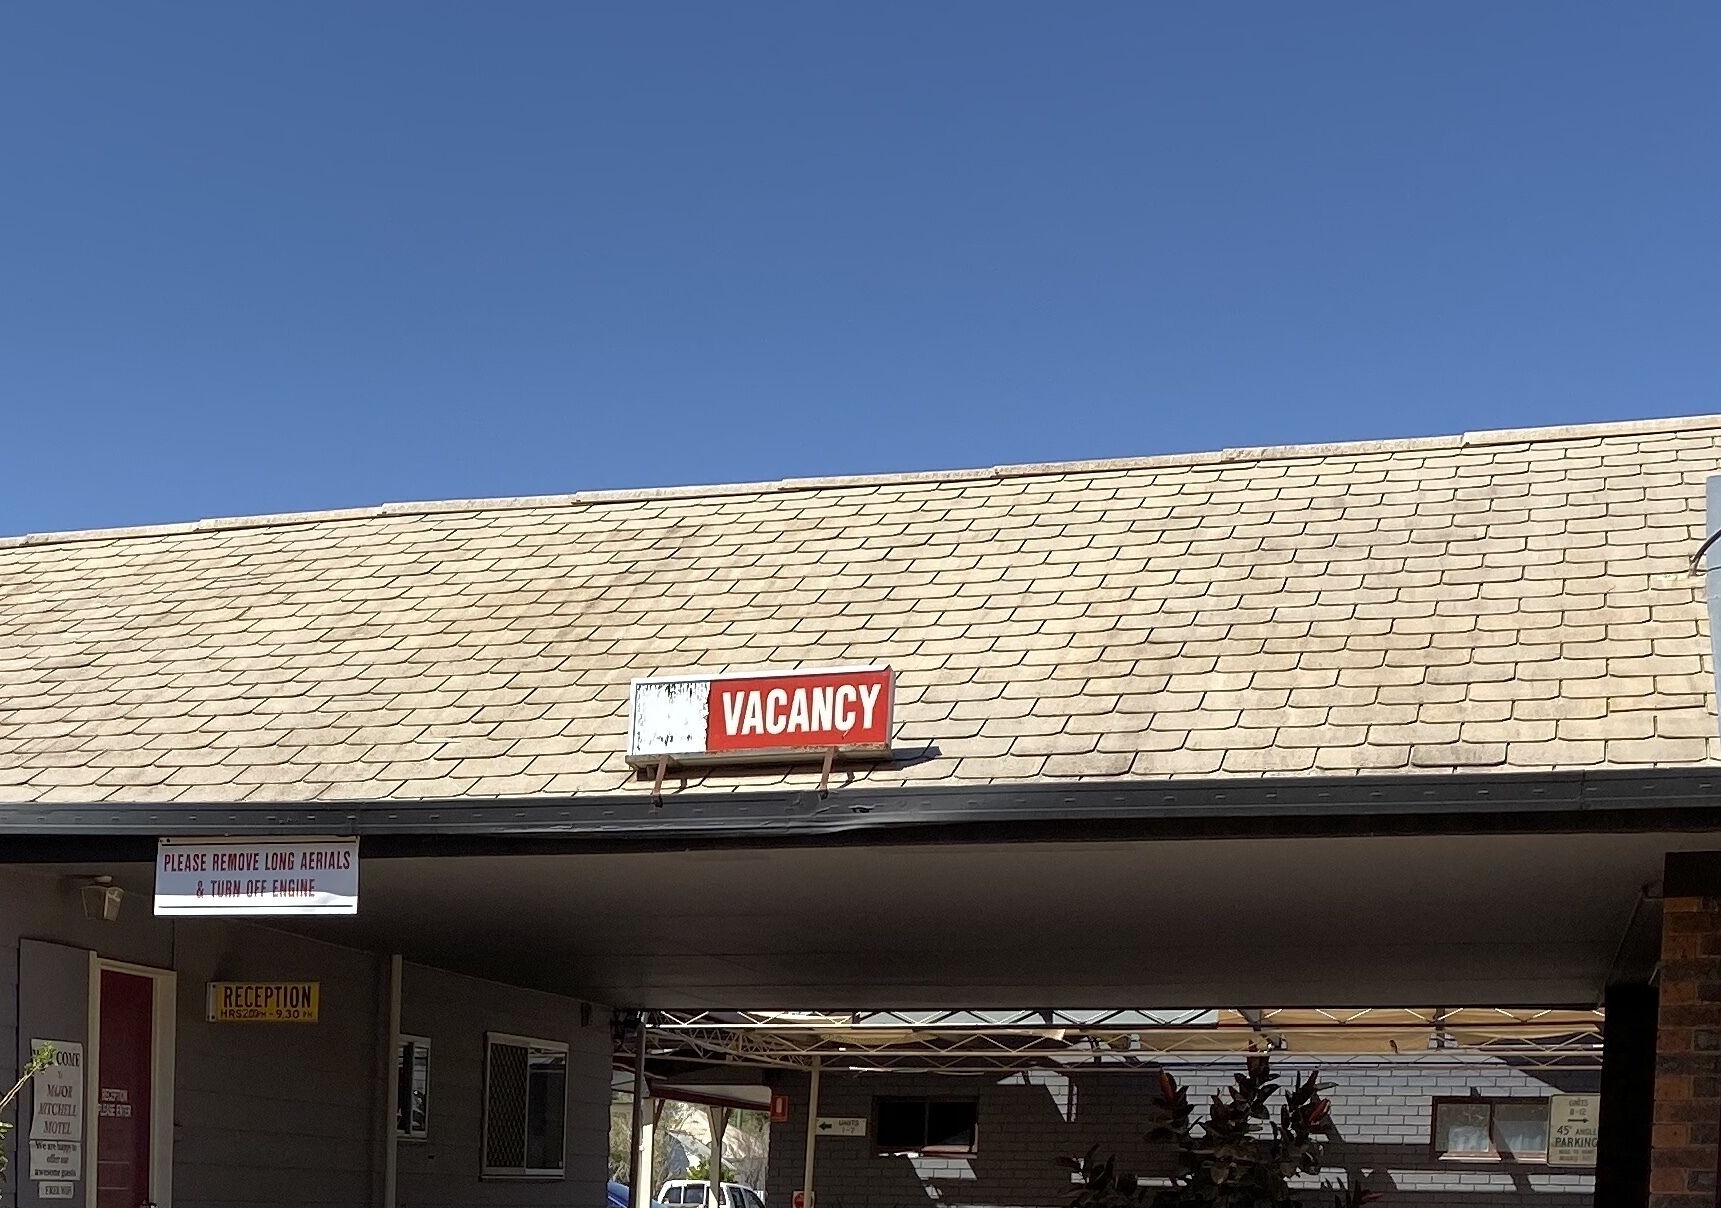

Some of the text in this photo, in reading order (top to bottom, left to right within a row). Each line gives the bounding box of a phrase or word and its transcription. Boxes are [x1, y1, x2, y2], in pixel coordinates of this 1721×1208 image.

[722, 683, 881, 736] VACANCY
[164, 850, 351, 872] PLEASE REMOVE LONG AERIALS
[196, 878, 316, 898] & TURN OFF ENGINE
[223, 986, 311, 1008] RECEPTION
[1555, 1137, 1598, 1148] PARKING
